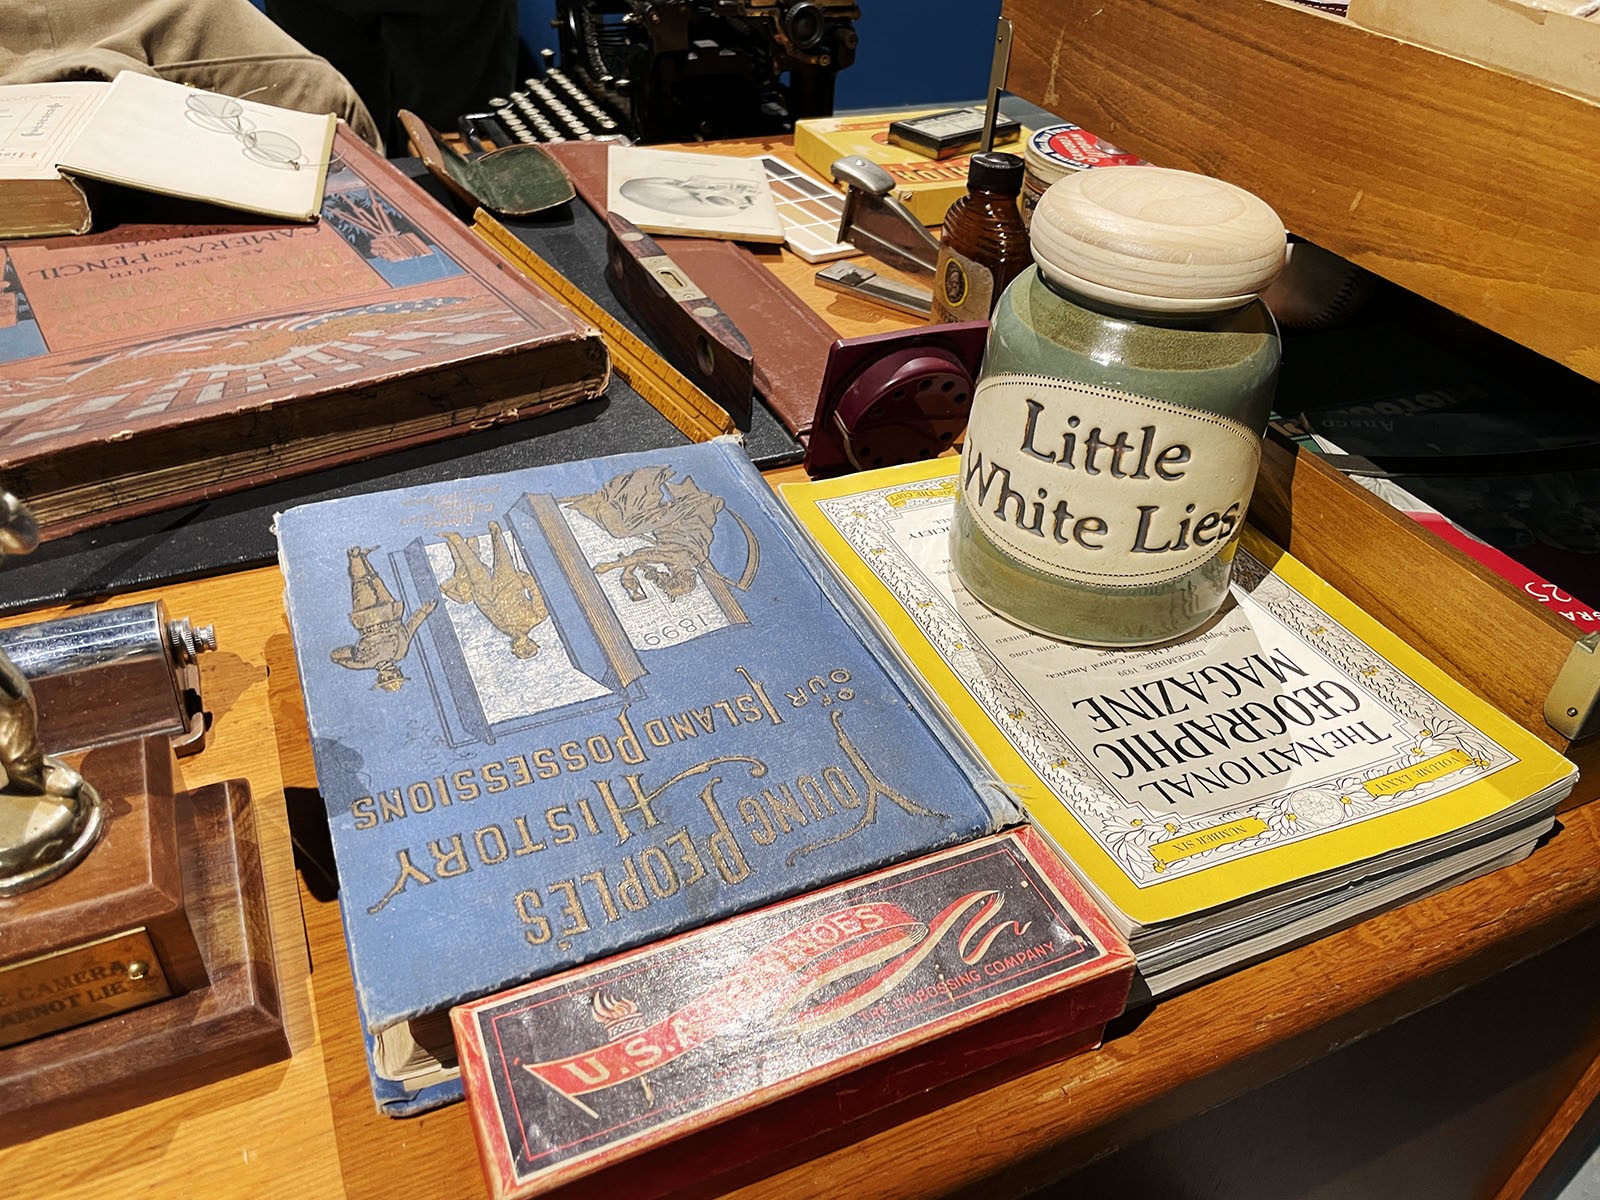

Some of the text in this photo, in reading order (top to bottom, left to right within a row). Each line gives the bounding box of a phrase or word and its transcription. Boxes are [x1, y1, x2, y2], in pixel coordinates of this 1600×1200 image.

[185, 225, 321, 253] CAMERA
[28, 253, 149, 280] PENCIL
[109, 267, 163, 279] WITH
[57, 289, 264, 338] ISLANDS
[1020, 399, 1191, 481] Little
[891, 491, 912, 503] COPY
[964, 437, 1241, 554] White Lies
[1524, 582, 1572, 602] 25
[644, 614, 708, 645] 1899
[1226, 624, 1251, 638] Map
[1009, 650, 1035, 659] LONG
[1037, 643, 1060, 653] JOHN
[1045, 665, 1089, 680] America,
[1090, 657, 1126, 672] Central
[1117, 666, 1139, 678] 1939
[821, 687, 856, 707] OF
[1072, 648, 1310, 733] MAGAZINE
[1093, 680, 1361, 780] GEOGRAPHIC
[351, 665, 852, 830] OUR ISLAND POSSESSIONS
[1138, 720, 1393, 804] THE NATIONAL
[1377, 755, 1461, 792] VOLUME LXXVI
[367, 755, 768, 914] HISTORY
[513, 709, 950, 951] YOUNG PEOPLE'S
[1173, 825, 1247, 853] NUMBER SIX
[984, 941, 1056, 977] COMPANY
[17, 958, 128, 1000] CAMERA
[86, 981, 125, 1002] LIE
